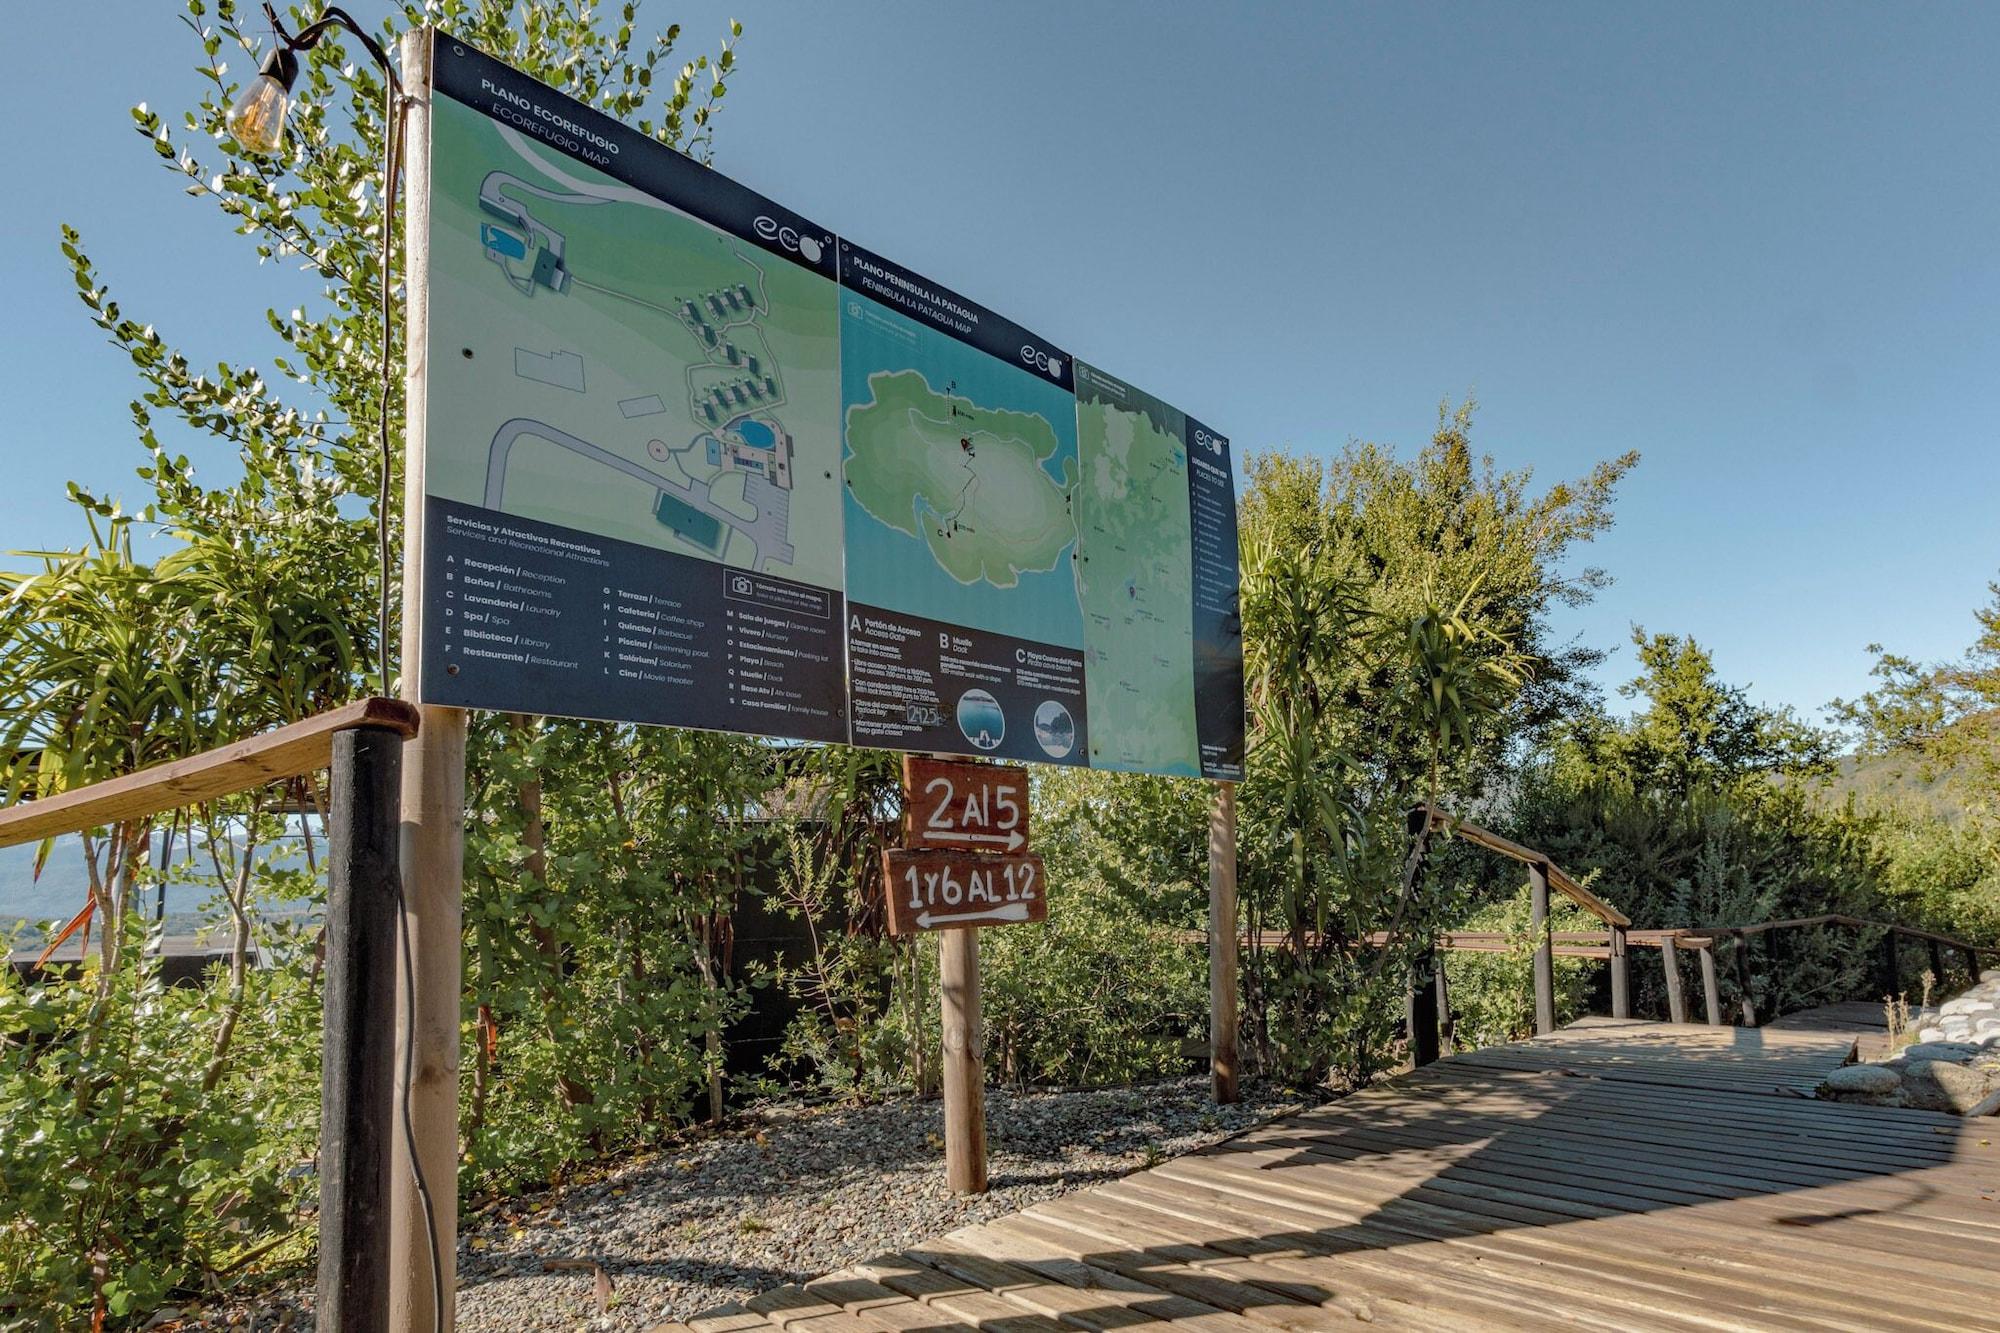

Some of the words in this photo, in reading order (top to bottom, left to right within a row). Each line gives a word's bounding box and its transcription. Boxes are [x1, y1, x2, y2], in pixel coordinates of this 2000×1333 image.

[482, 79, 530, 110] PLANO
[534, 105, 619, 155] ECOREFUGIO
[493, 104, 579, 152] ECOREFUGIO
[582, 148, 610, 166] MAP
[854, 257, 884, 278] PLANO
[885, 272, 929, 301] PENINSULA
[930, 294, 940, 306] LA
[942, 300, 979, 324] PATAGUA
[862, 277, 905, 304] PENINSULA
[907, 298, 917, 310] LA
[918, 303, 954, 326] PATAGUA
[955, 321, 971, 334] MAP
[447, 515, 491, 532] Servicios
[493, 526, 499, 534] y
[501, 528, 548, 544] Atractivos
[550, 538, 601, 555] Recreativos
[447, 526, 486, 541] Services
[488, 535, 507, 545] and
[509, 540, 564, 557] Recreational
[565, 552, 609, 567] Attractions
[464, 558, 515, 575] Recepción
[522, 569, 566, 584] Reception
[464, 576, 495, 588] Baños
[503, 583, 552, 598] Bathrooms
[464, 594, 519, 609] Lavanderia
[526, 604, 562, 618] Laundry
[618, 590, 648, 602] Terraza
[654, 596, 681, 608] Terrace
[464, 611, 483, 622] Spa
[492, 616, 510, 626] Spa
[661, 614, 685, 624] Coffee
[686, 619, 705, 628] shop
[739, 613, 754, 621] Sala
[850, 615, 861, 632] A
[865, 618, 887, 630] Portón
[888, 624, 896, 632] de
[897, 626, 921, 637] Acceso
[618, 622, 651, 633] Quincho
[739, 627, 761, 636] Vivero
[865, 628, 888, 638] Access
[464, 629, 513, 643] Biblioteca
[520, 638, 550, 650] Library
[618, 637, 647, 648] Piscina
[653, 643, 691, 656] Swimming
[739, 641, 794, 656] Estacionamiento
[939, 633, 949, 648] B
[464, 647, 524, 662] Restaurante
[531, 656, 578, 668] Restaurant
[740, 656, 759, 665] Playa
[1016, 648, 1025, 663] C
[619, 670, 637, 678] Cine
[643, 673, 665, 681] Movie
[667, 675, 693, 685] theater
[740, 670, 763, 679] Muelle
[925, 778, 954, 828] 2
[996, 785, 1020, 830] 5
[1004, 863, 1035, 901] 12
